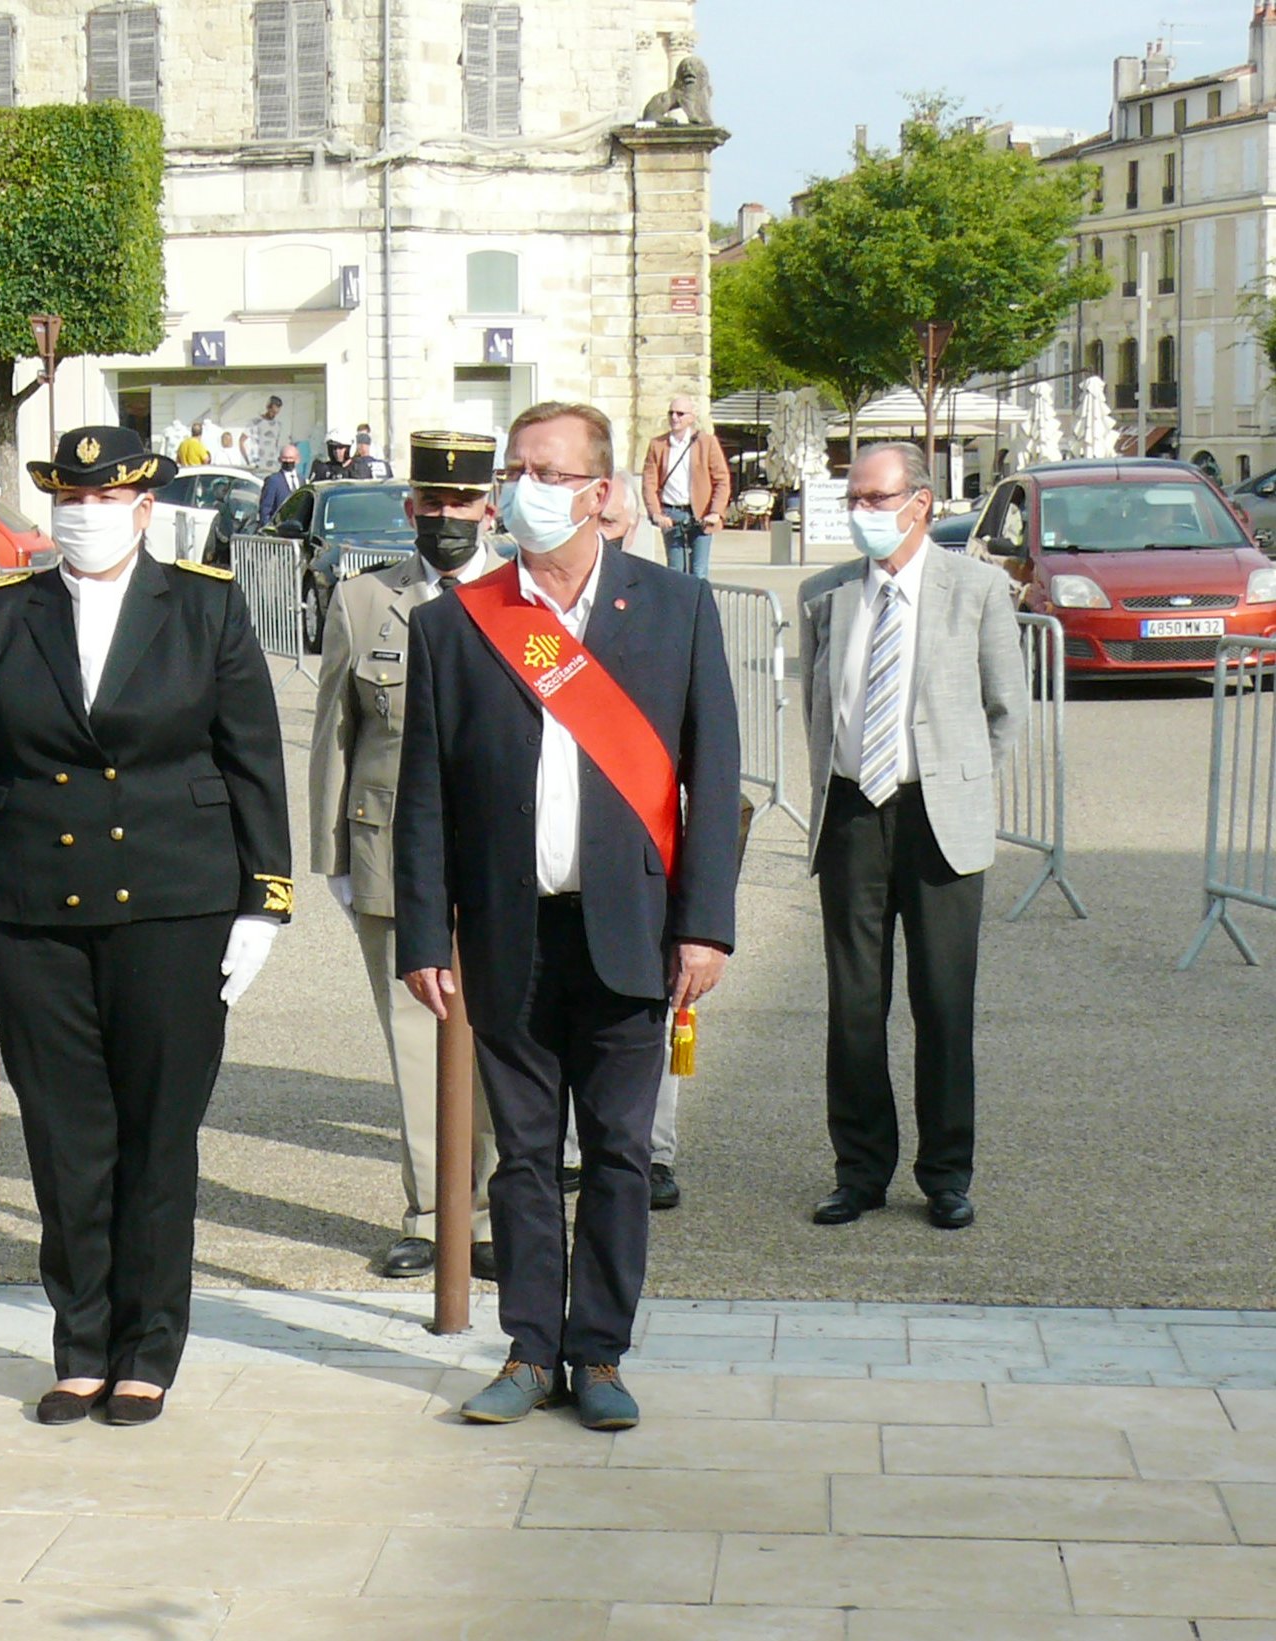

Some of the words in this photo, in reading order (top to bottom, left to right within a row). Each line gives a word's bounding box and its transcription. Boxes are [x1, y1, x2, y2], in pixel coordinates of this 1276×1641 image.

[1149, 622, 1182, 635] 4850
[1205, 620, 1220, 633] 32
[538, 654, 585, 693] Occitanie
